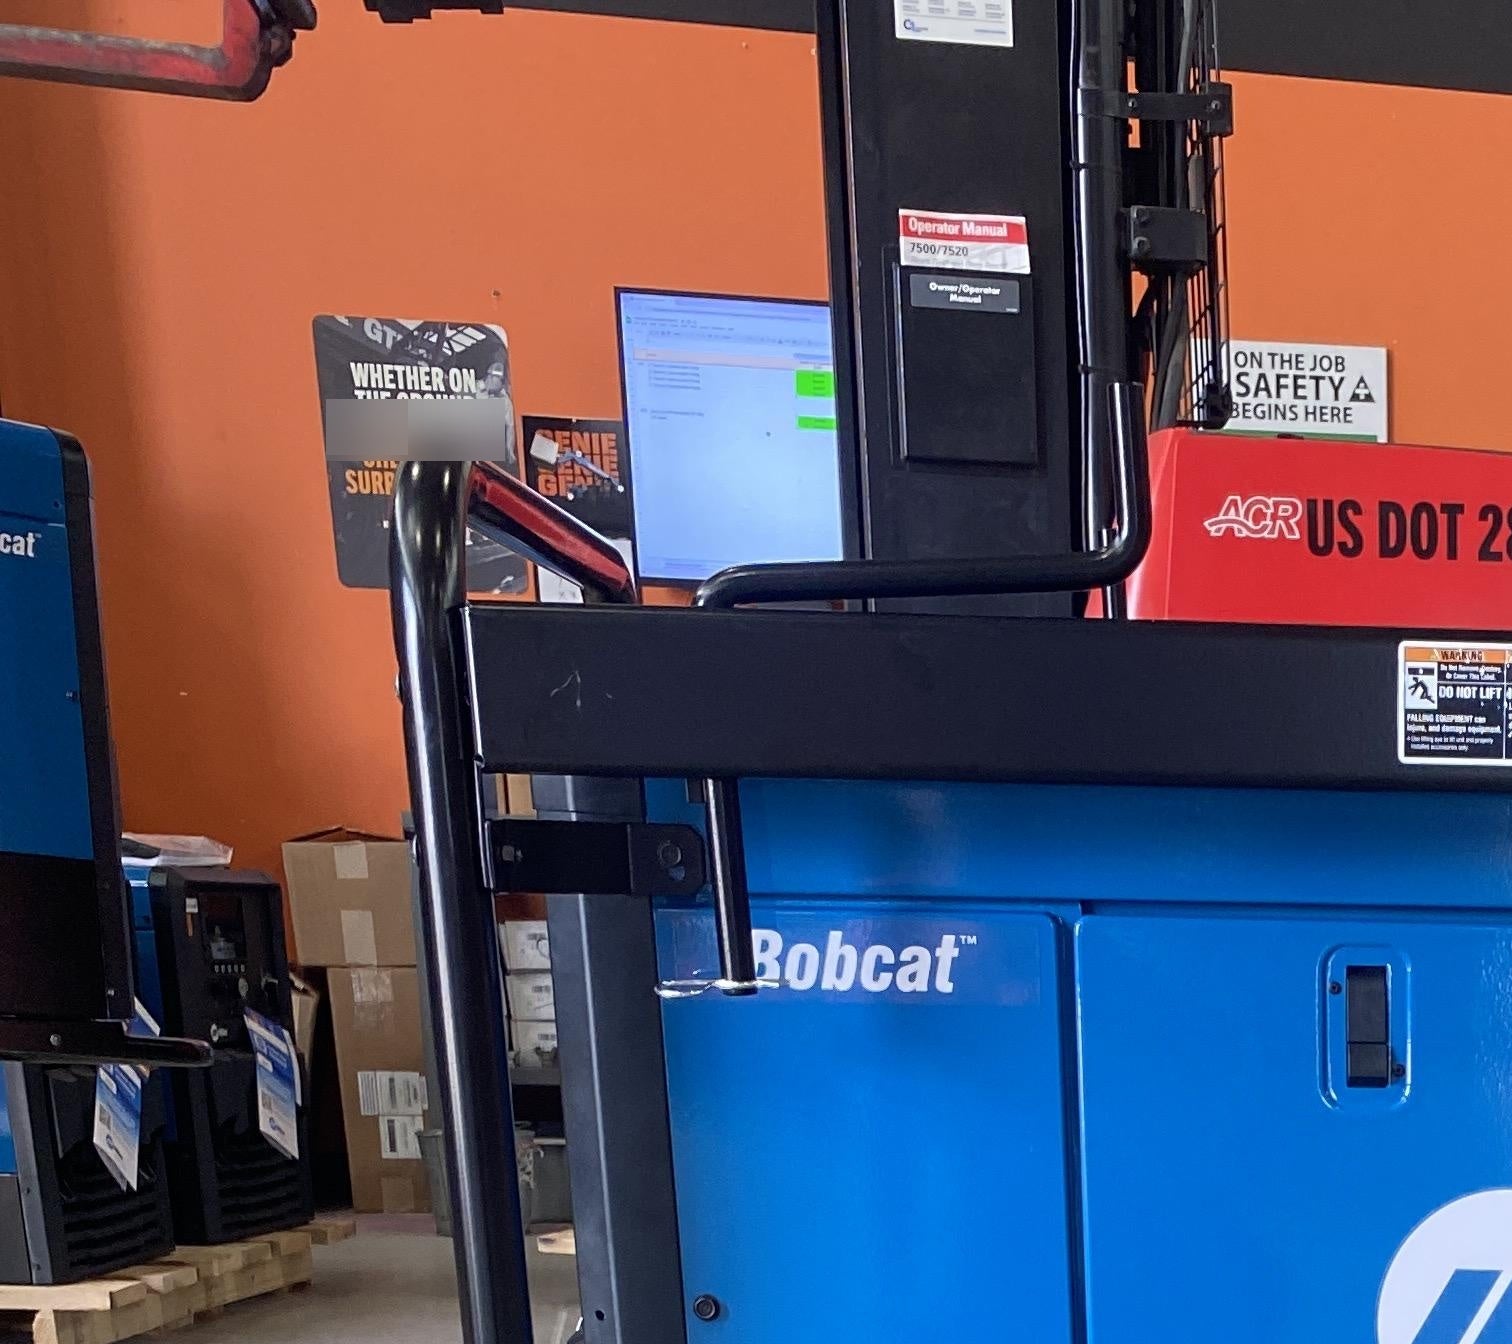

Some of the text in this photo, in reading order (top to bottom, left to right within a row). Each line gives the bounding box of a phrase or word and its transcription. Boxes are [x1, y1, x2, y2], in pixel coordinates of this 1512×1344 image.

[908, 217, 1007, 237] Operator Manual
[910, 242, 968, 256] 7500/7520
[929, 282, 1000, 295] Owner/Operator
[949, 294, 982, 303] Manual
[1234, 350, 1346, 373] ON THE JOB
[349, 361, 477, 393] WHETHER ON
[1235, 371, 1345, 401] SAFETY
[1231, 401, 1353, 424] BEGINS HERE
[1203, 495, 1303, 539] ACR
[1306, 497, 1363, 558] US
[1378, 500, 1465, 561] DOT
[1438, 686, 1502, 699] DO NOT LIFT
